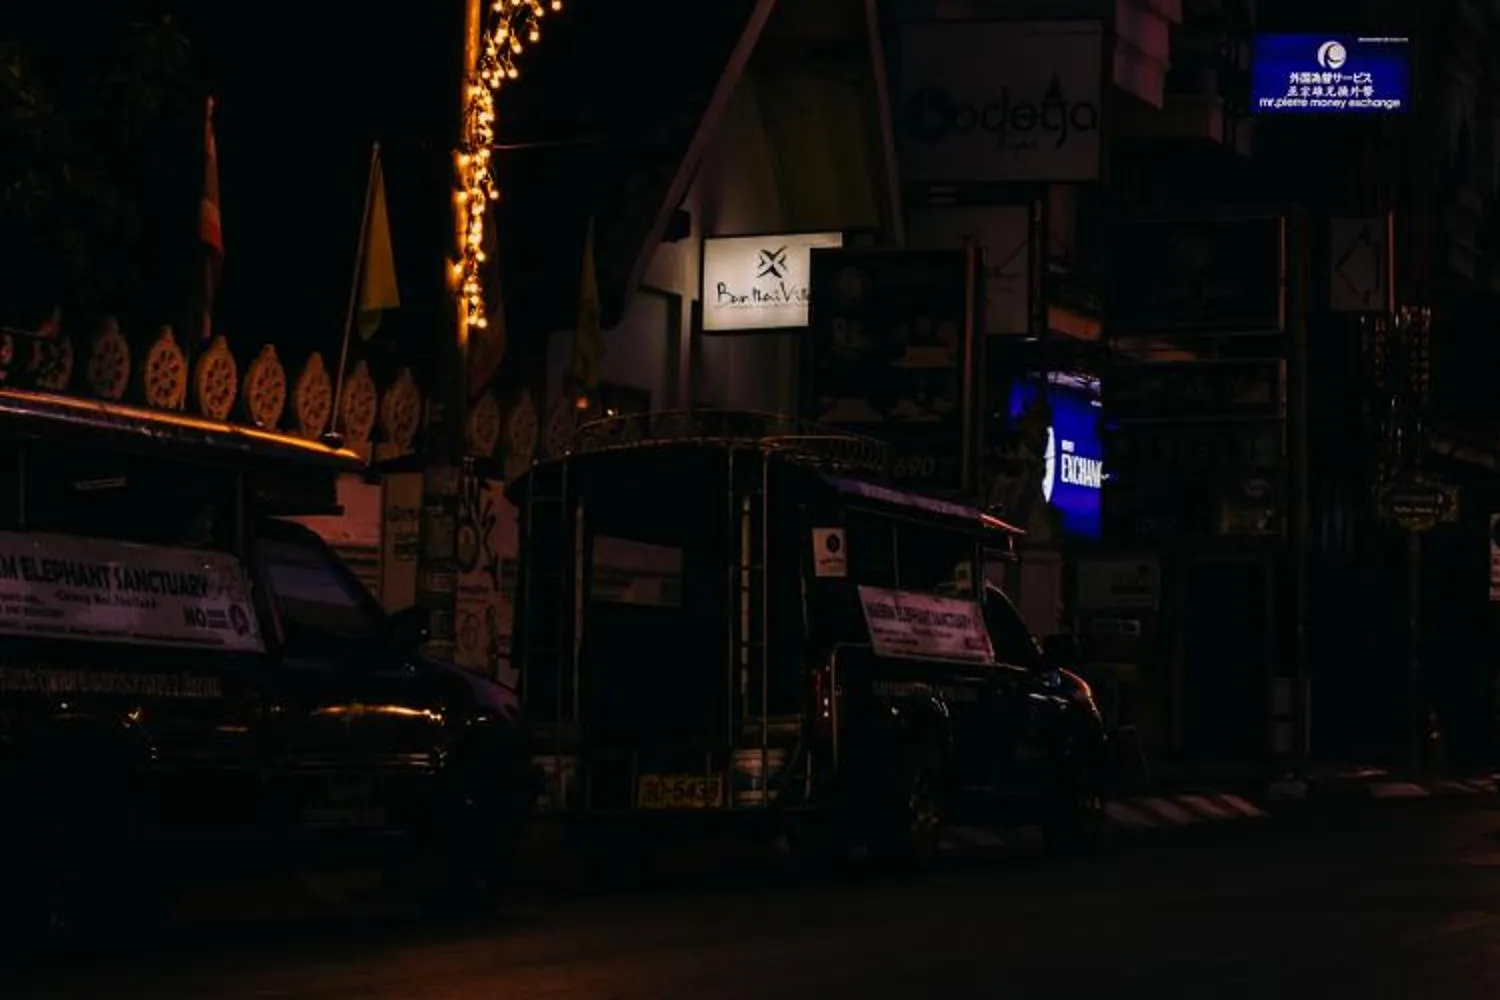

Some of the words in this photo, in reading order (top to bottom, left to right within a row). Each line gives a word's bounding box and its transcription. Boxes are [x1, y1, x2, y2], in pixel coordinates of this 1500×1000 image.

[1309, 98, 1347, 111] money
[1347, 97, 1402, 111] exchange
[22, 557, 111, 589] ELEPHANT
[115, 566, 209, 597] SANCTUARY
